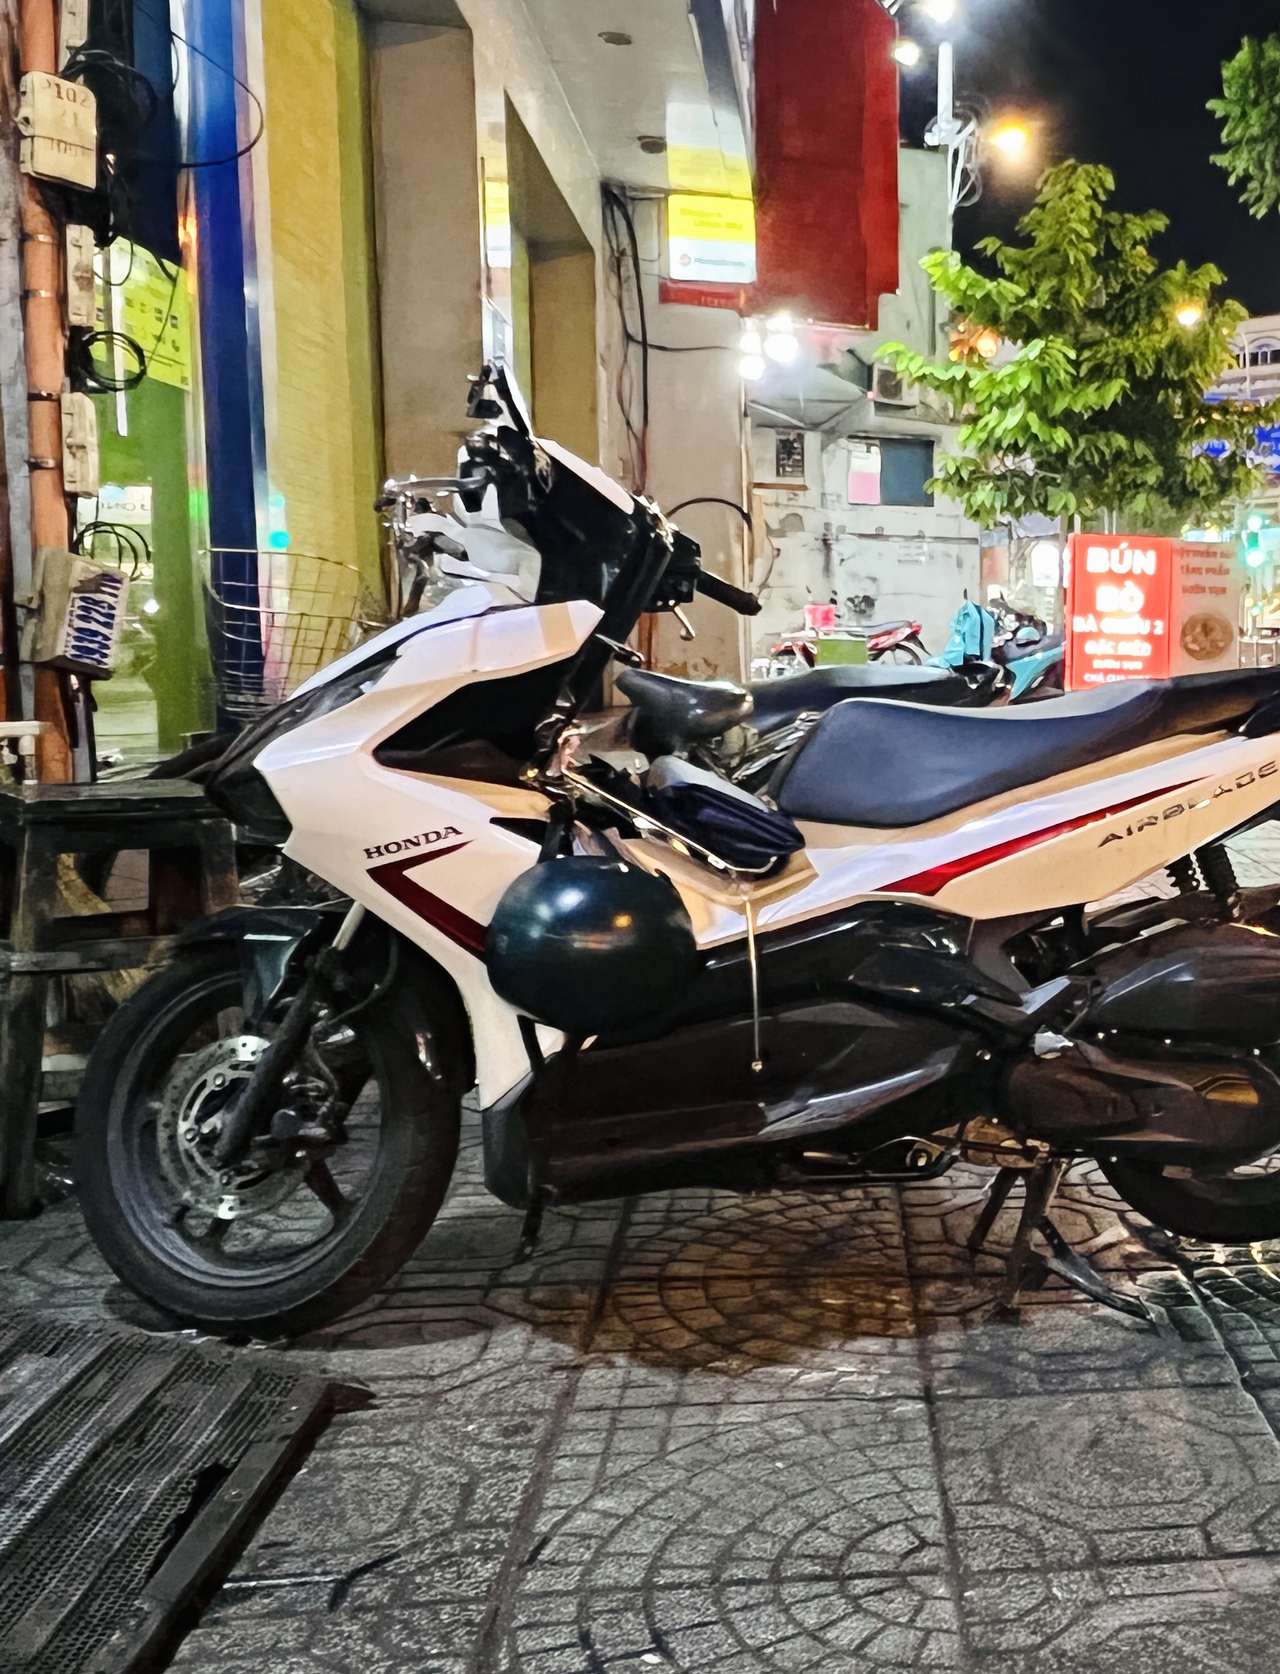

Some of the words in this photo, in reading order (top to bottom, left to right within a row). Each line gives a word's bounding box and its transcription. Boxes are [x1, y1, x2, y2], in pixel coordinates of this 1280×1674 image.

[1086, 542, 1156, 575] BÚN
[1153, 620, 1164, 635] 2
[363, 826, 463, 859] HONDA
